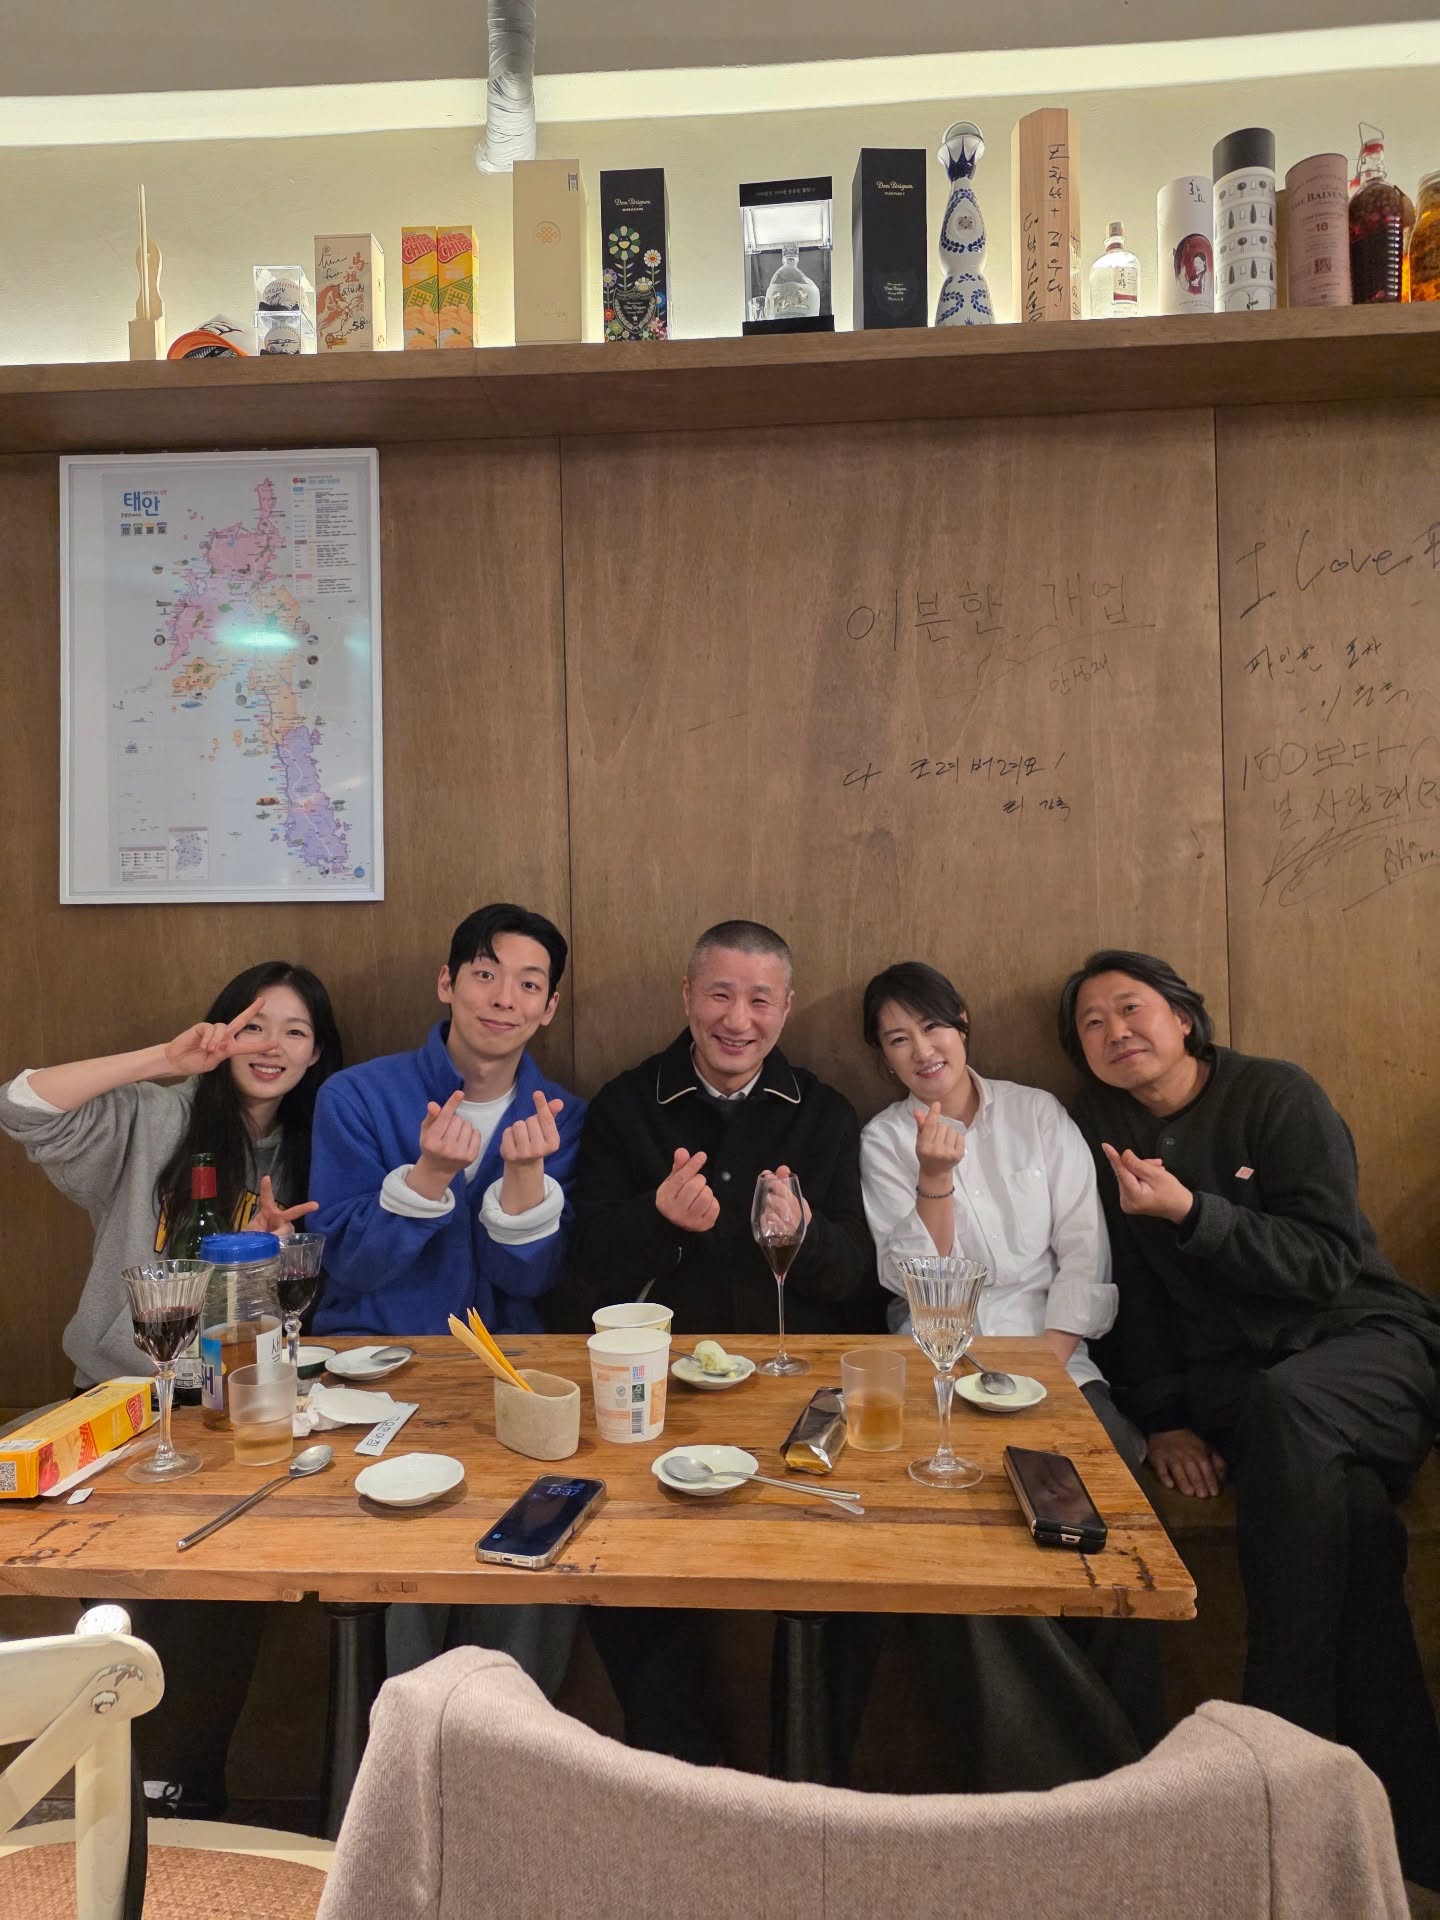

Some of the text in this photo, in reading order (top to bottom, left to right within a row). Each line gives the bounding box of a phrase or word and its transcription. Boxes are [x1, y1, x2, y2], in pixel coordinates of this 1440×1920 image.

[1315, 222, 1328, 232] 18
[123, 491, 161, 517] 태안
[546, 1487, 580, 1496] 12:37
